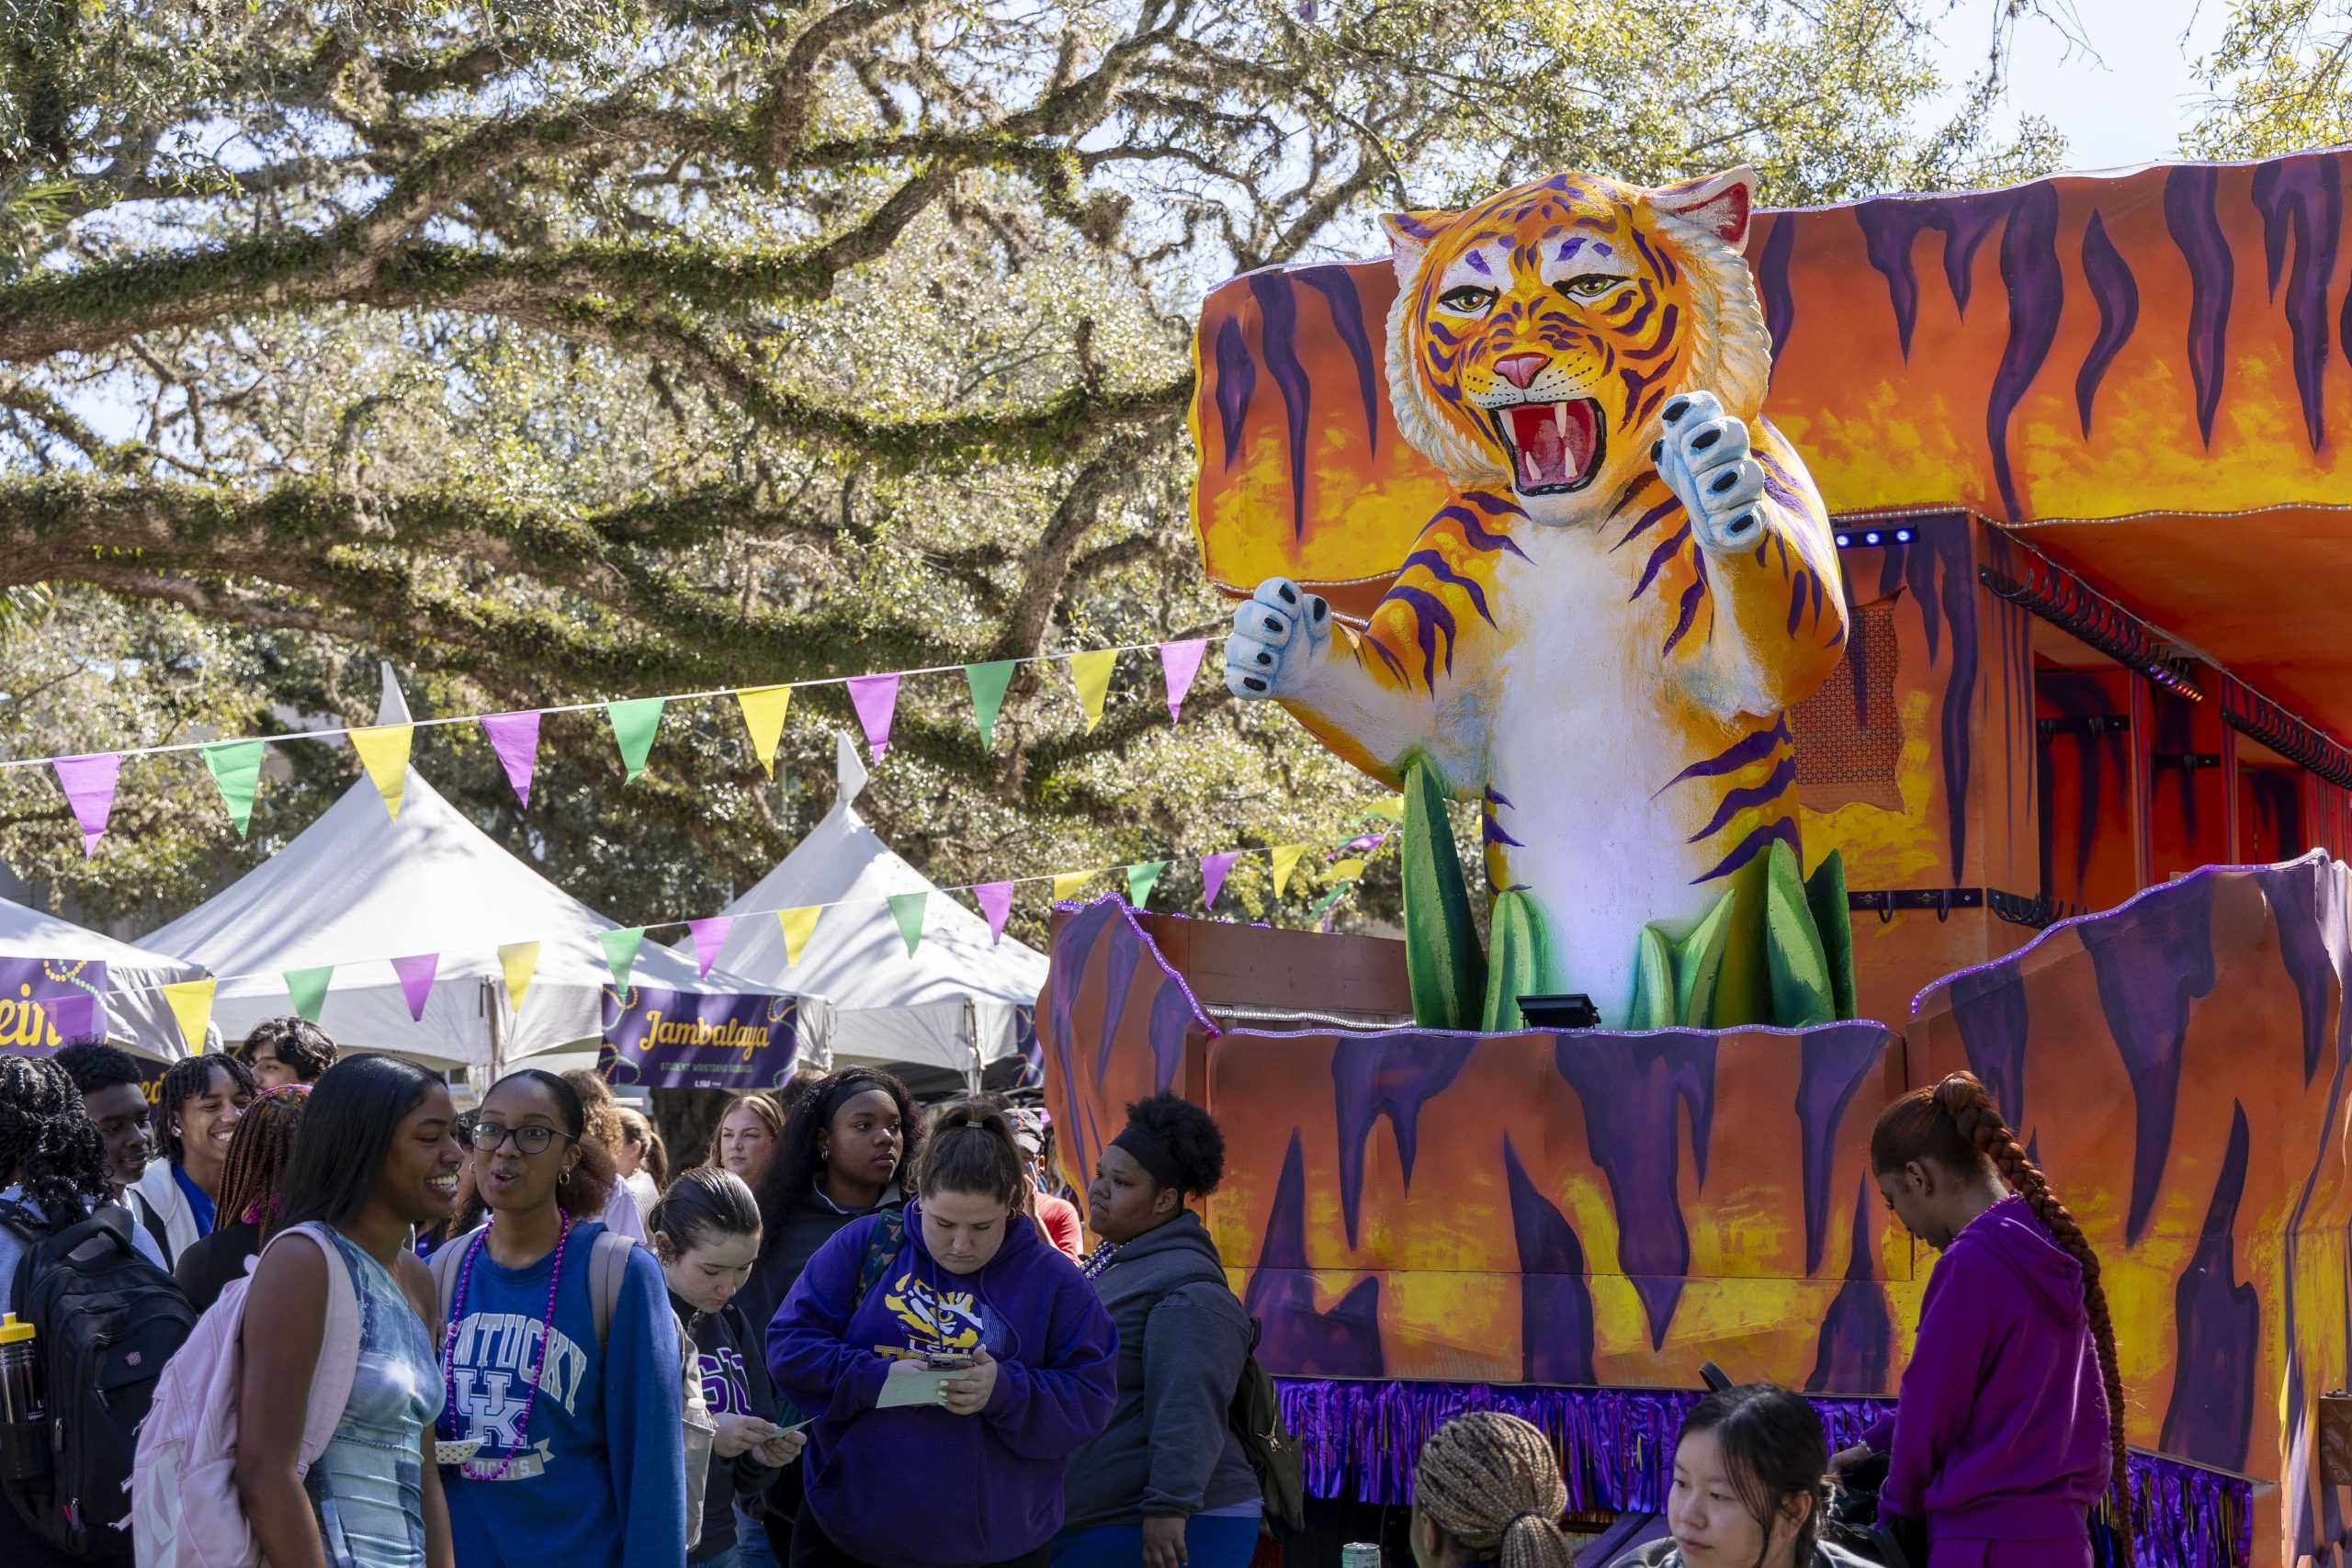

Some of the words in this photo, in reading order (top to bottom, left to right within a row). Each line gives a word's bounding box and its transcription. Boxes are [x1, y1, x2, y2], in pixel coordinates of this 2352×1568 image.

[639, 1010, 770, 1061] Jambalaya
[694, 1079, 711, 1088] LSU
[443, 1313, 587, 1417] NTUCKY
[697, 1347, 752, 1416] SU
[454, 1369, 528, 1449] UK
